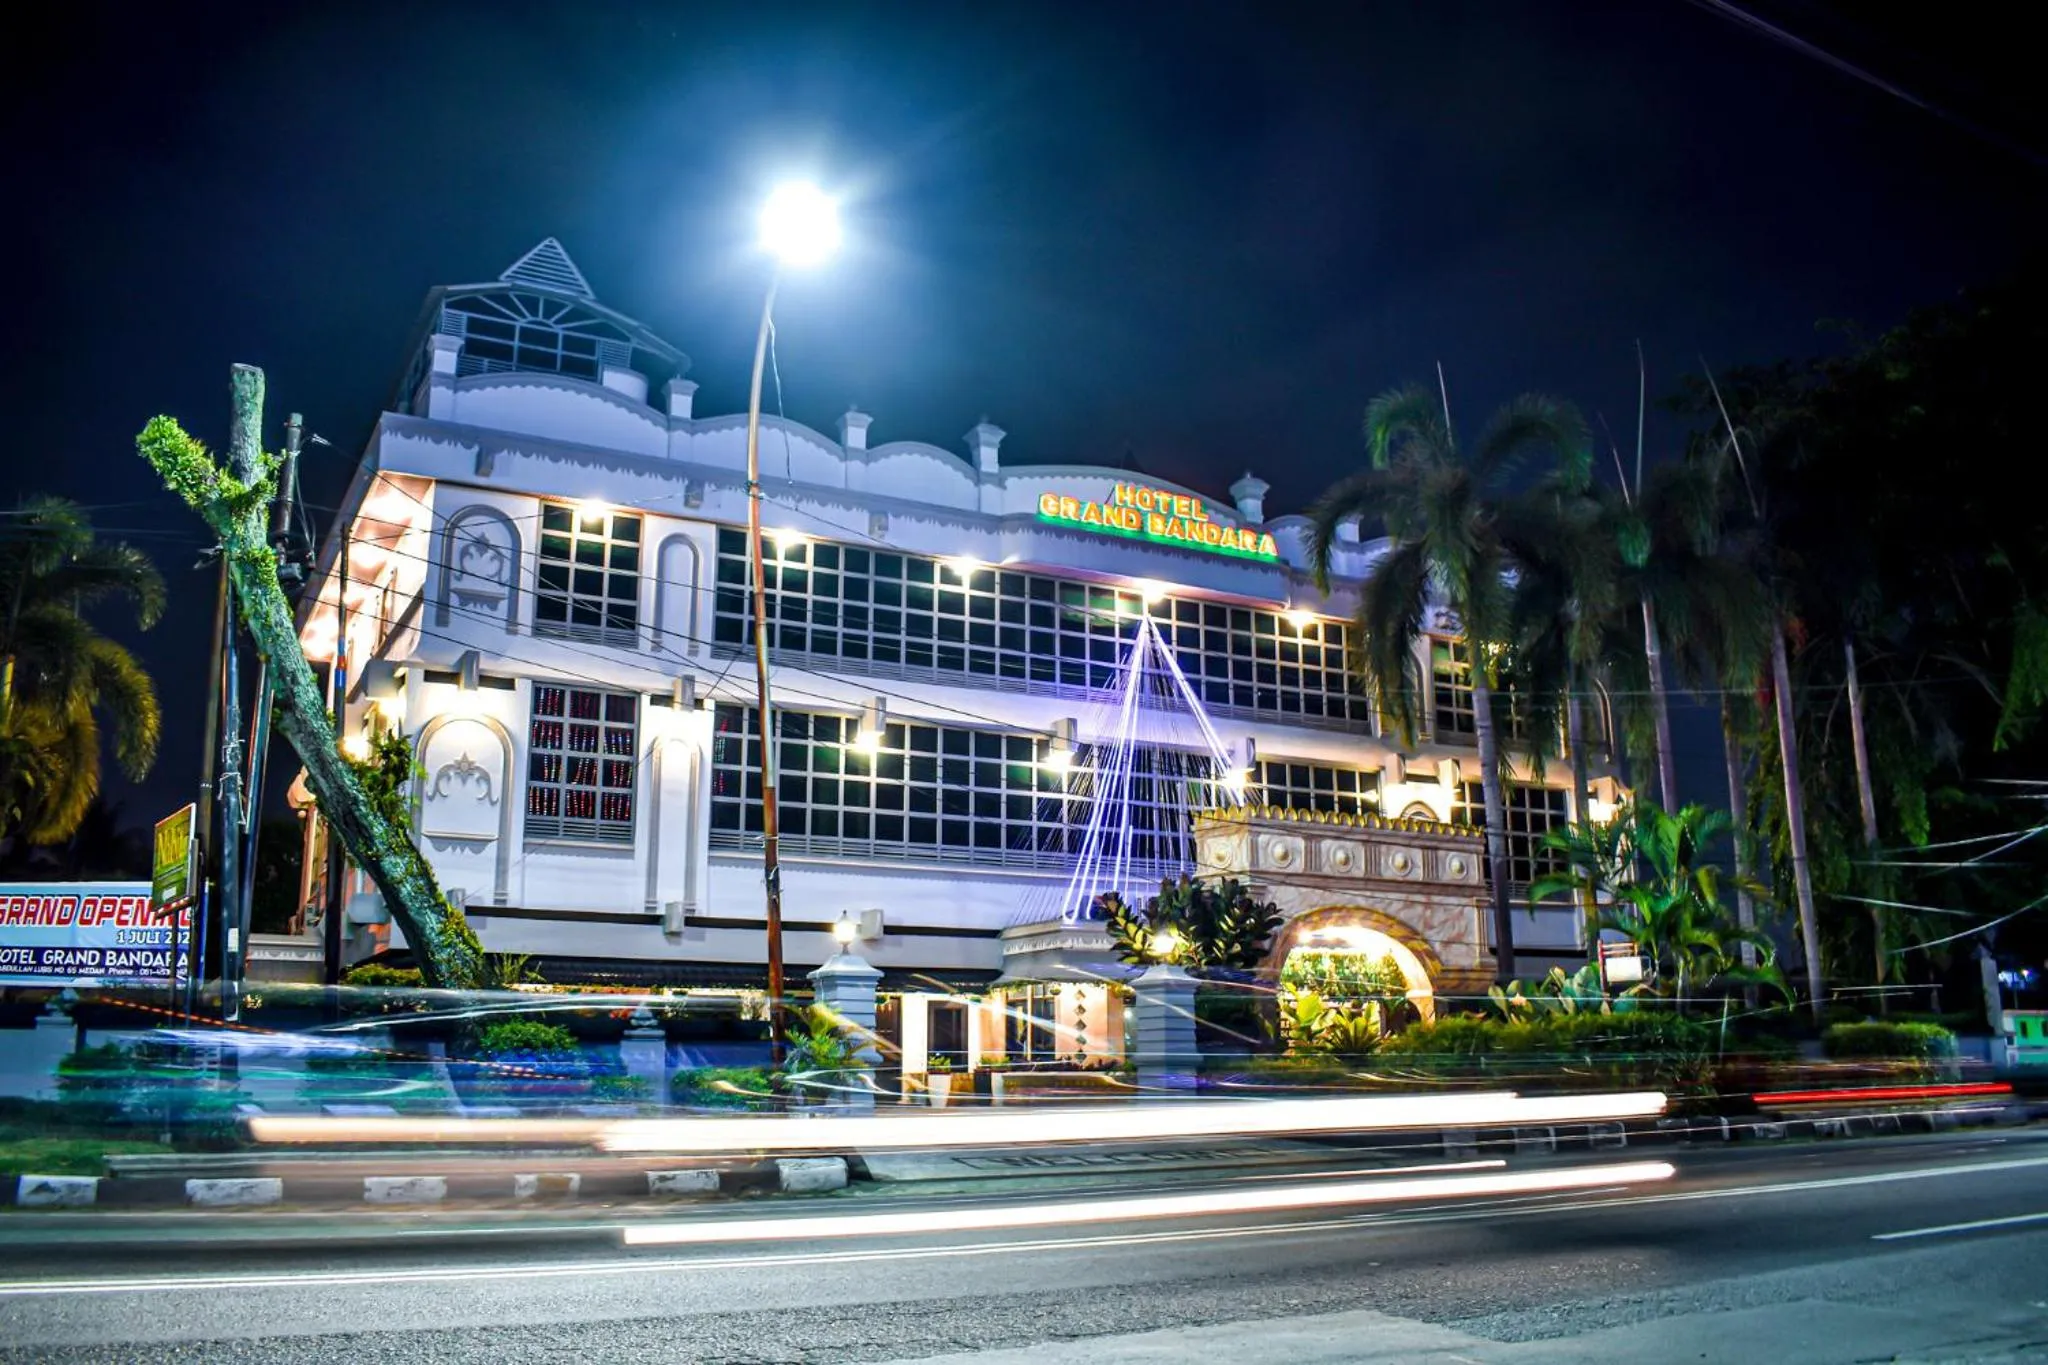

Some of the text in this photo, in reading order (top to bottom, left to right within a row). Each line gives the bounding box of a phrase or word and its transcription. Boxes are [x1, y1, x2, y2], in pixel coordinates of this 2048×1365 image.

[1114, 482, 1209, 522] HOTEL
[1039, 492, 1279, 557] GRAND BANDARA
[117, 931, 125, 944] 1
[129, 931, 161, 945] JULI
[0, 948, 36, 965] OTEL
[43, 949, 101, 966] GRAND
